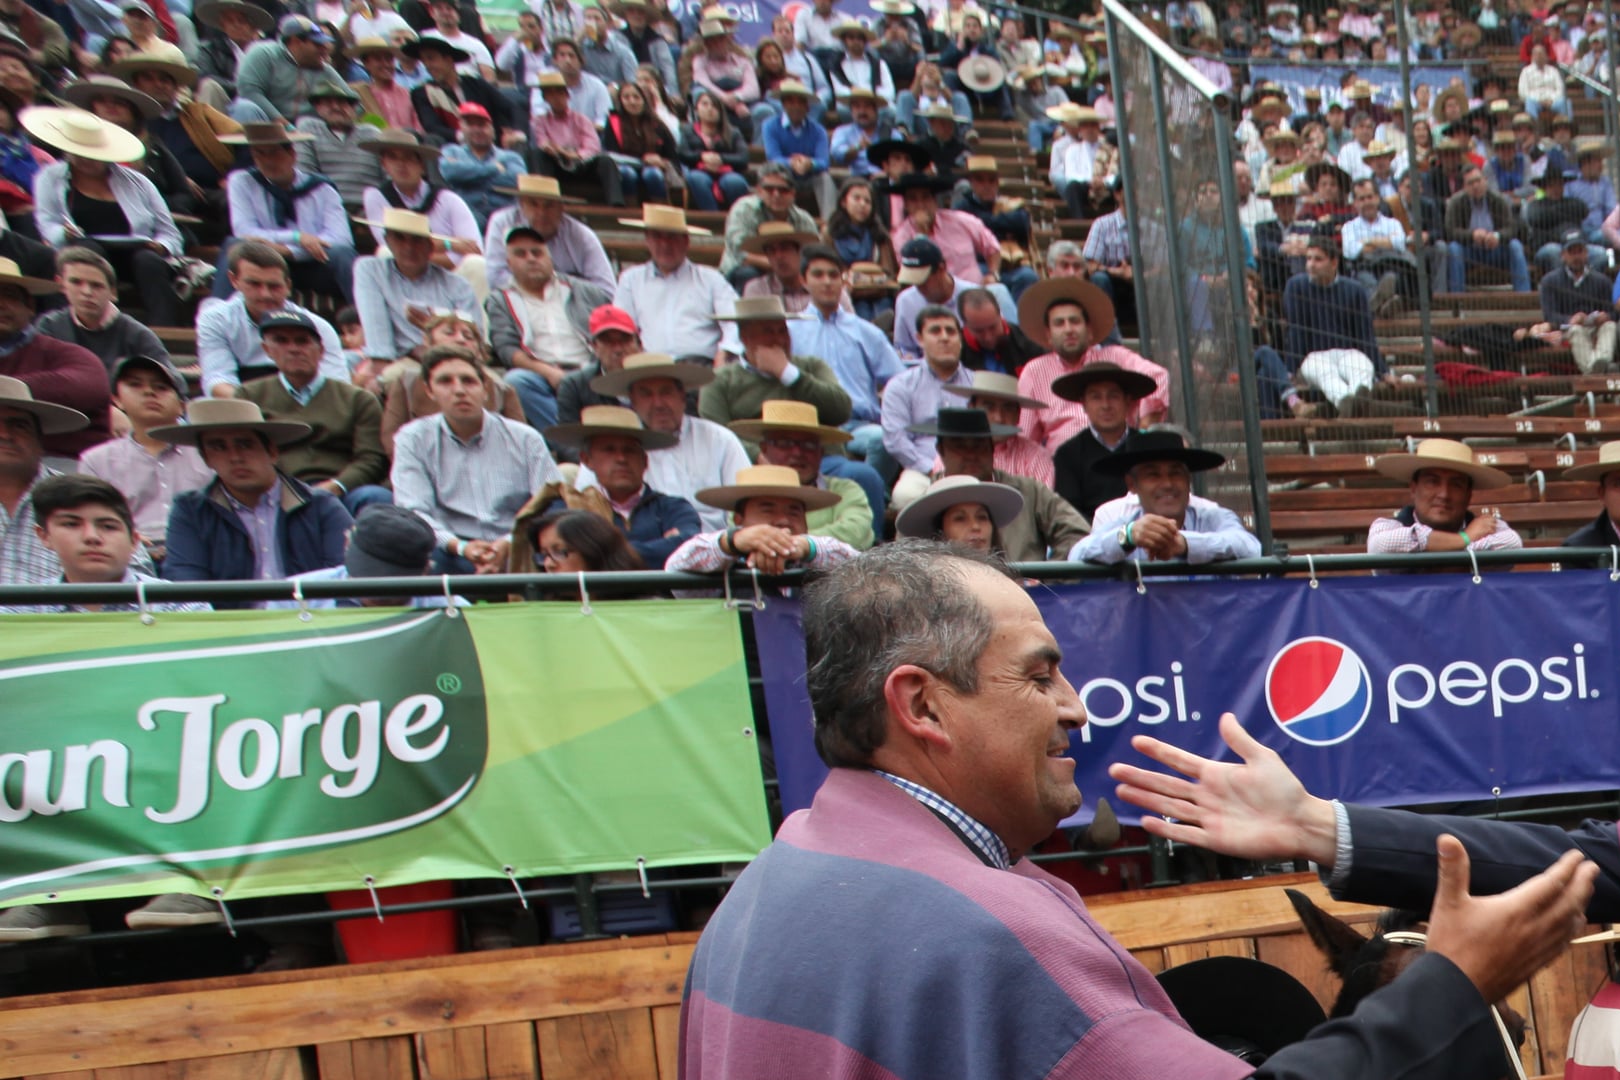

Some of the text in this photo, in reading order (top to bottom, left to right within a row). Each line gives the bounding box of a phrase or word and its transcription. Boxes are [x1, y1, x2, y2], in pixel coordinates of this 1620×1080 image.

[1080, 661, 1190, 743] psi
[0, 693, 450, 824] an Jorge
